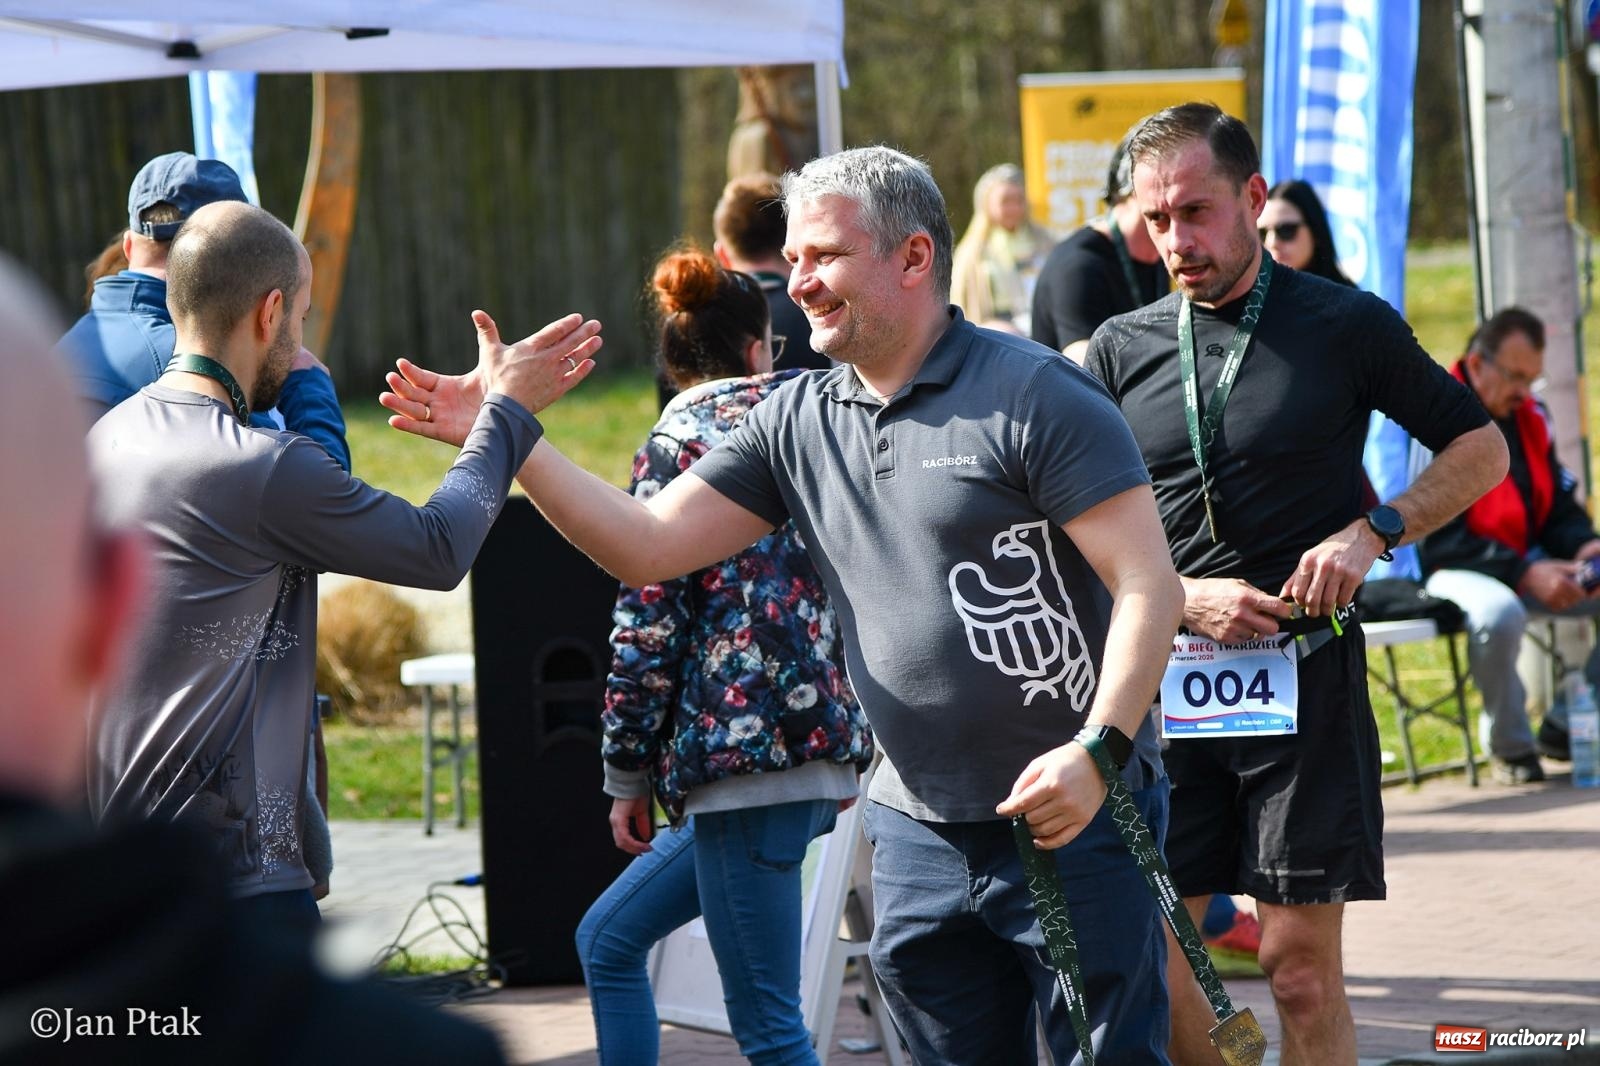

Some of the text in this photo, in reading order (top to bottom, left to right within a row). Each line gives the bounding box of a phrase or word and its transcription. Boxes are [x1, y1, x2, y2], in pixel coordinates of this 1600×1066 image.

[922, 454, 978, 470] RACIBÓRZ
[1188, 642, 1214, 653] BIEG
[1218, 639, 1281, 652] TWARDZIEL
[1183, 668, 1275, 708] 004
